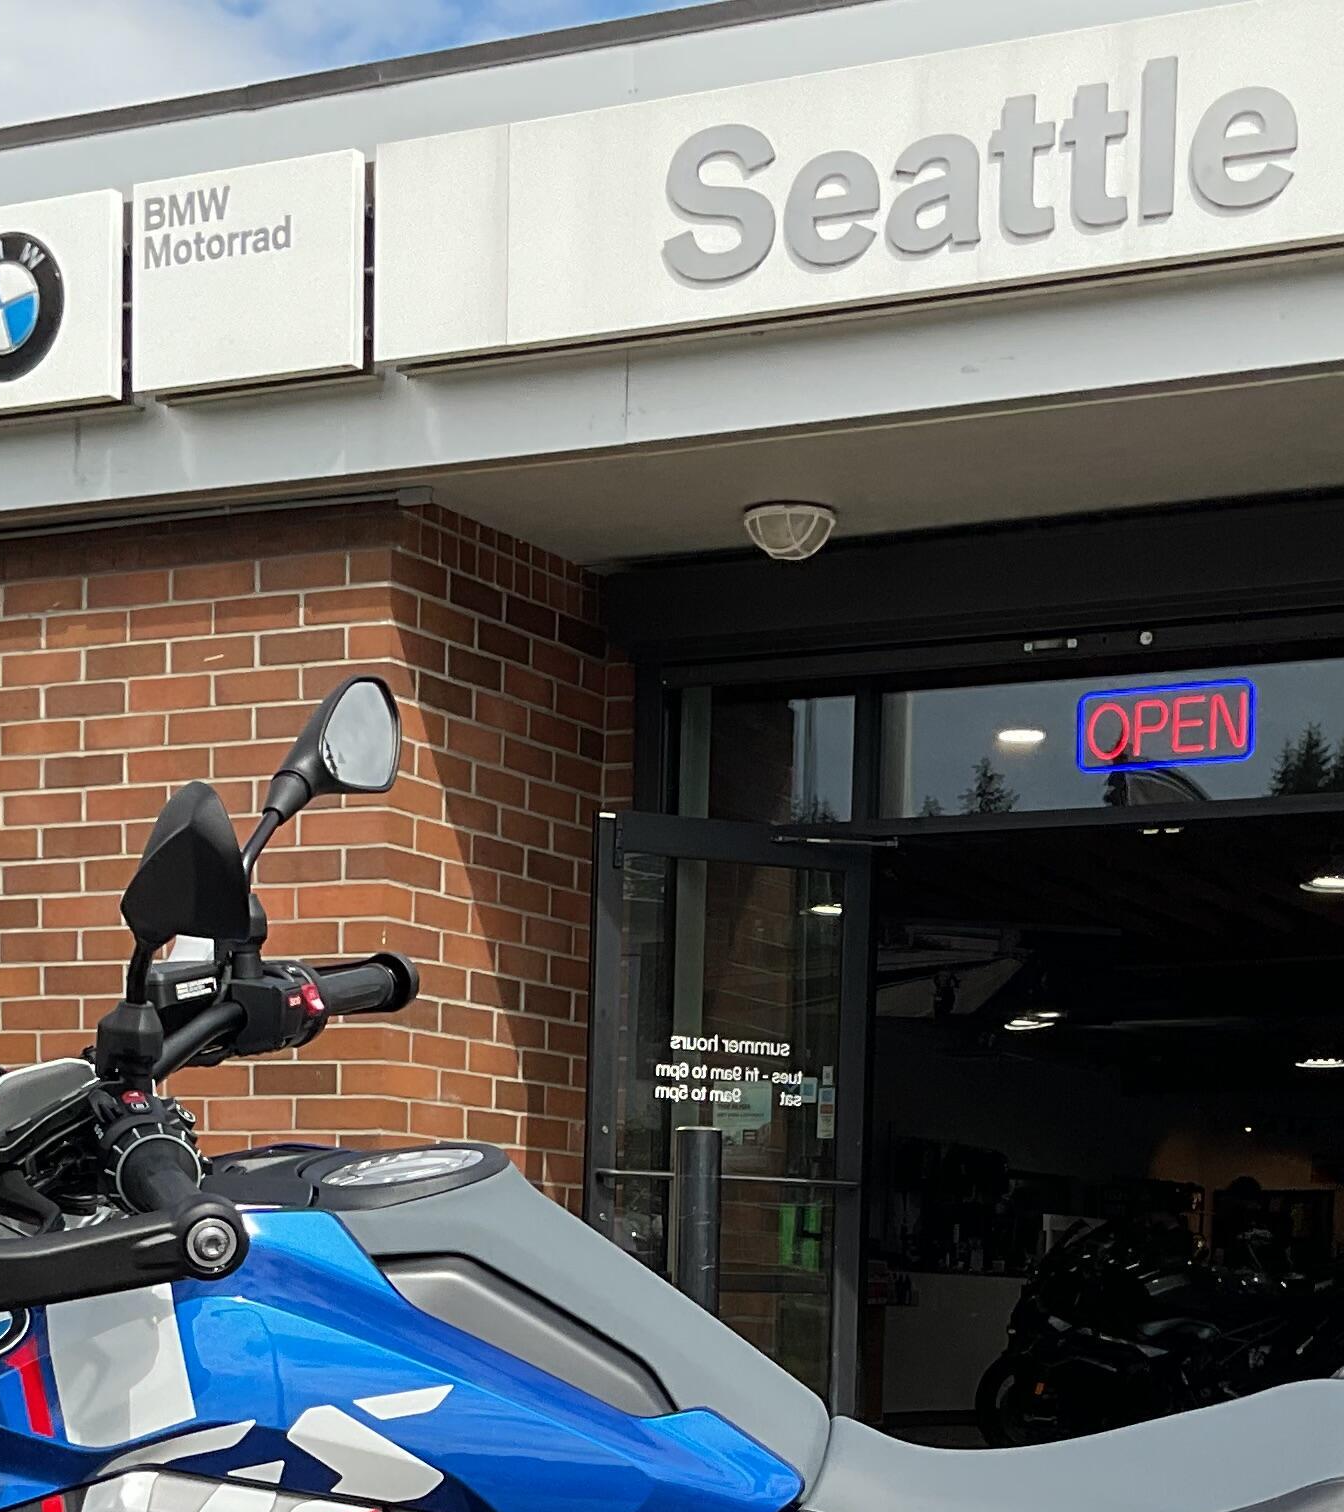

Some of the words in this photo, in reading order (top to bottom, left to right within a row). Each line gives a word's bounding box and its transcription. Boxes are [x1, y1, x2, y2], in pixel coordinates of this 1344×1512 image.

[661, 55, 1299, 284] Seattle
[144, 185, 231, 232] BMW
[144, 214, 292, 270] Motorrad
[1086, 688, 1248, 761] OPEN
